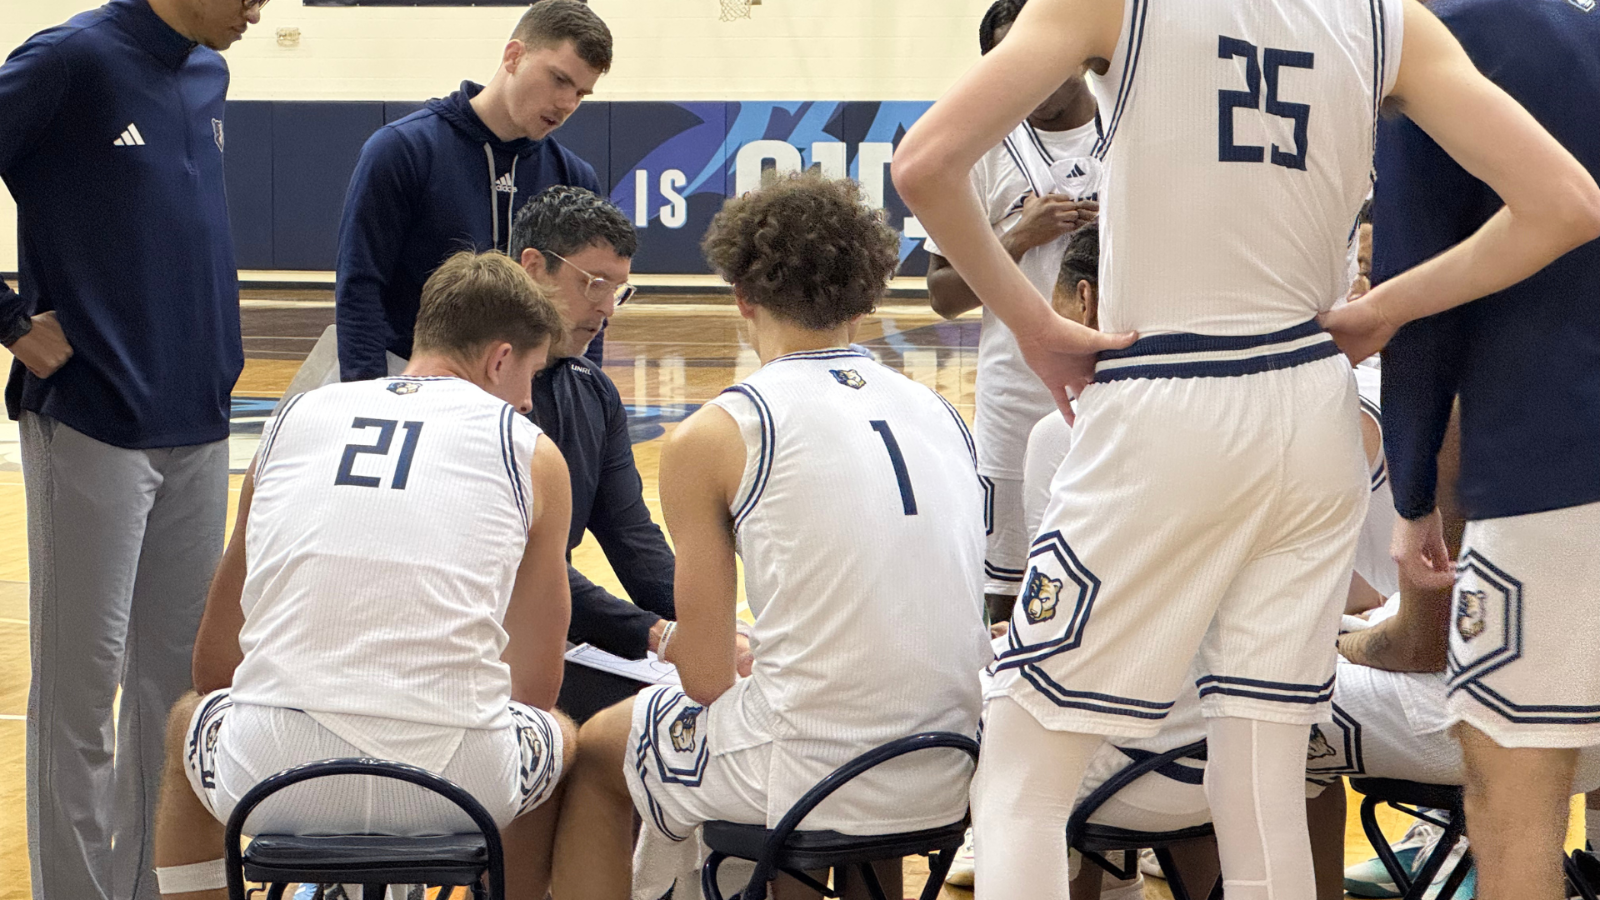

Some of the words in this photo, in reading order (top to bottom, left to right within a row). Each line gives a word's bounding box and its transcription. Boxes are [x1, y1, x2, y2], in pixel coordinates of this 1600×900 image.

[1218, 34, 1314, 171] 25
[635, 169, 687, 228] IS
[571, 364, 591, 375] UNRL
[334, 416, 424, 490] 21
[868, 420, 918, 515] 1
